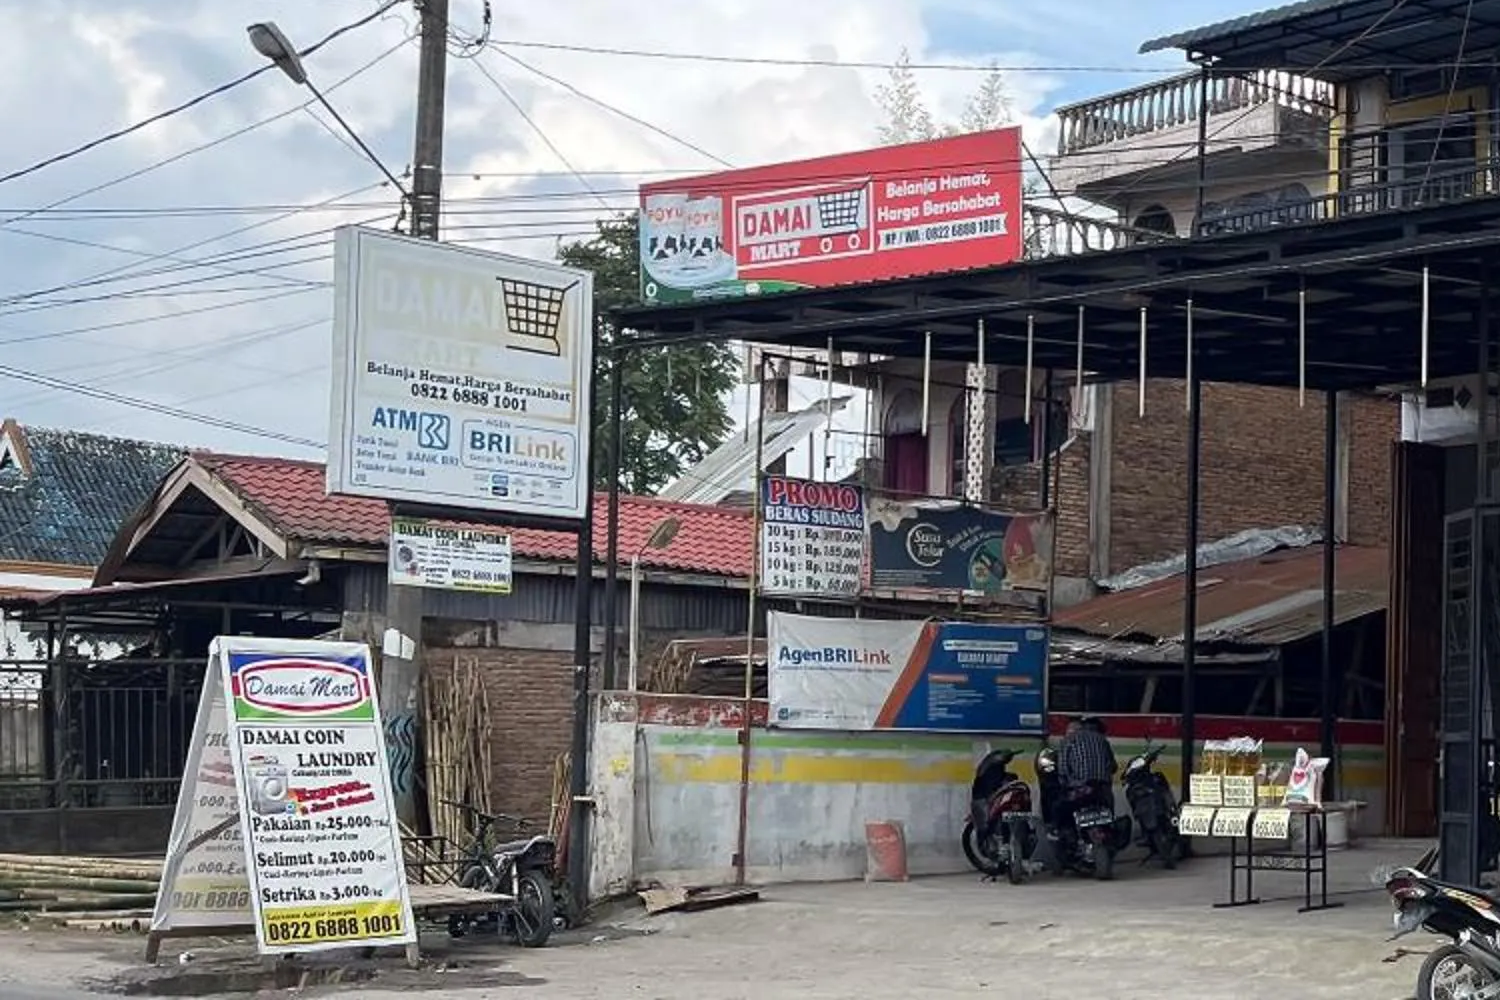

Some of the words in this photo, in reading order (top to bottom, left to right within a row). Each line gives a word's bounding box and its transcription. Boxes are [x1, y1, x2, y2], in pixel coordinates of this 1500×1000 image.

[886, 178, 937, 199] Belanja
[939, 170, 990, 192] Hemat,
[877, 204, 919, 223] Harga
[923, 192, 1001, 217] Bersahabat
[743, 204, 812, 238] DAMAI
[925, 224, 950, 242] 0822
[952, 222, 977, 237] 6888
[751, 238, 801, 262] MART
[367, 361, 415, 380] Belanja
[505, 382, 571, 402] Bersahabat
[411, 383, 448, 400] 0822
[453, 389, 489, 407] 6888
[494, 394, 527, 412] 1001
[372, 407, 417, 432] ATM
[470, 430, 566, 461] BRILink
[767, 477, 859, 513] PROMO
[765, 505, 810, 522] BERAS
[399, 523, 433, 538] DAMAI
[435, 527, 459, 541] COIN
[782, 526, 795, 541] kg
[914, 529, 942, 543] Susu
[768, 541, 780, 553] 15
[782, 542, 795, 557] kg
[768, 558, 780, 570] 10
[782, 559, 796, 573] kg
[773, 575, 780, 587] 5
[782, 575, 796, 589] kg
[779, 645, 891, 665] AgenBRILink
[246, 675, 307, 697] Damai
[310, 675, 357, 697] Mart
[242, 729, 300, 745] DAMAI
[304, 729, 345, 745] COIN
[297, 751, 377, 767] LAUNDRY
[252, 816, 311, 832] Pakaian
[257, 852, 314, 867] Selimut
[262, 886, 317, 903] Setrika
[268, 920, 312, 942] 0822
[315, 917, 359, 937] 6888
[362, 913, 401, 935] 1001
